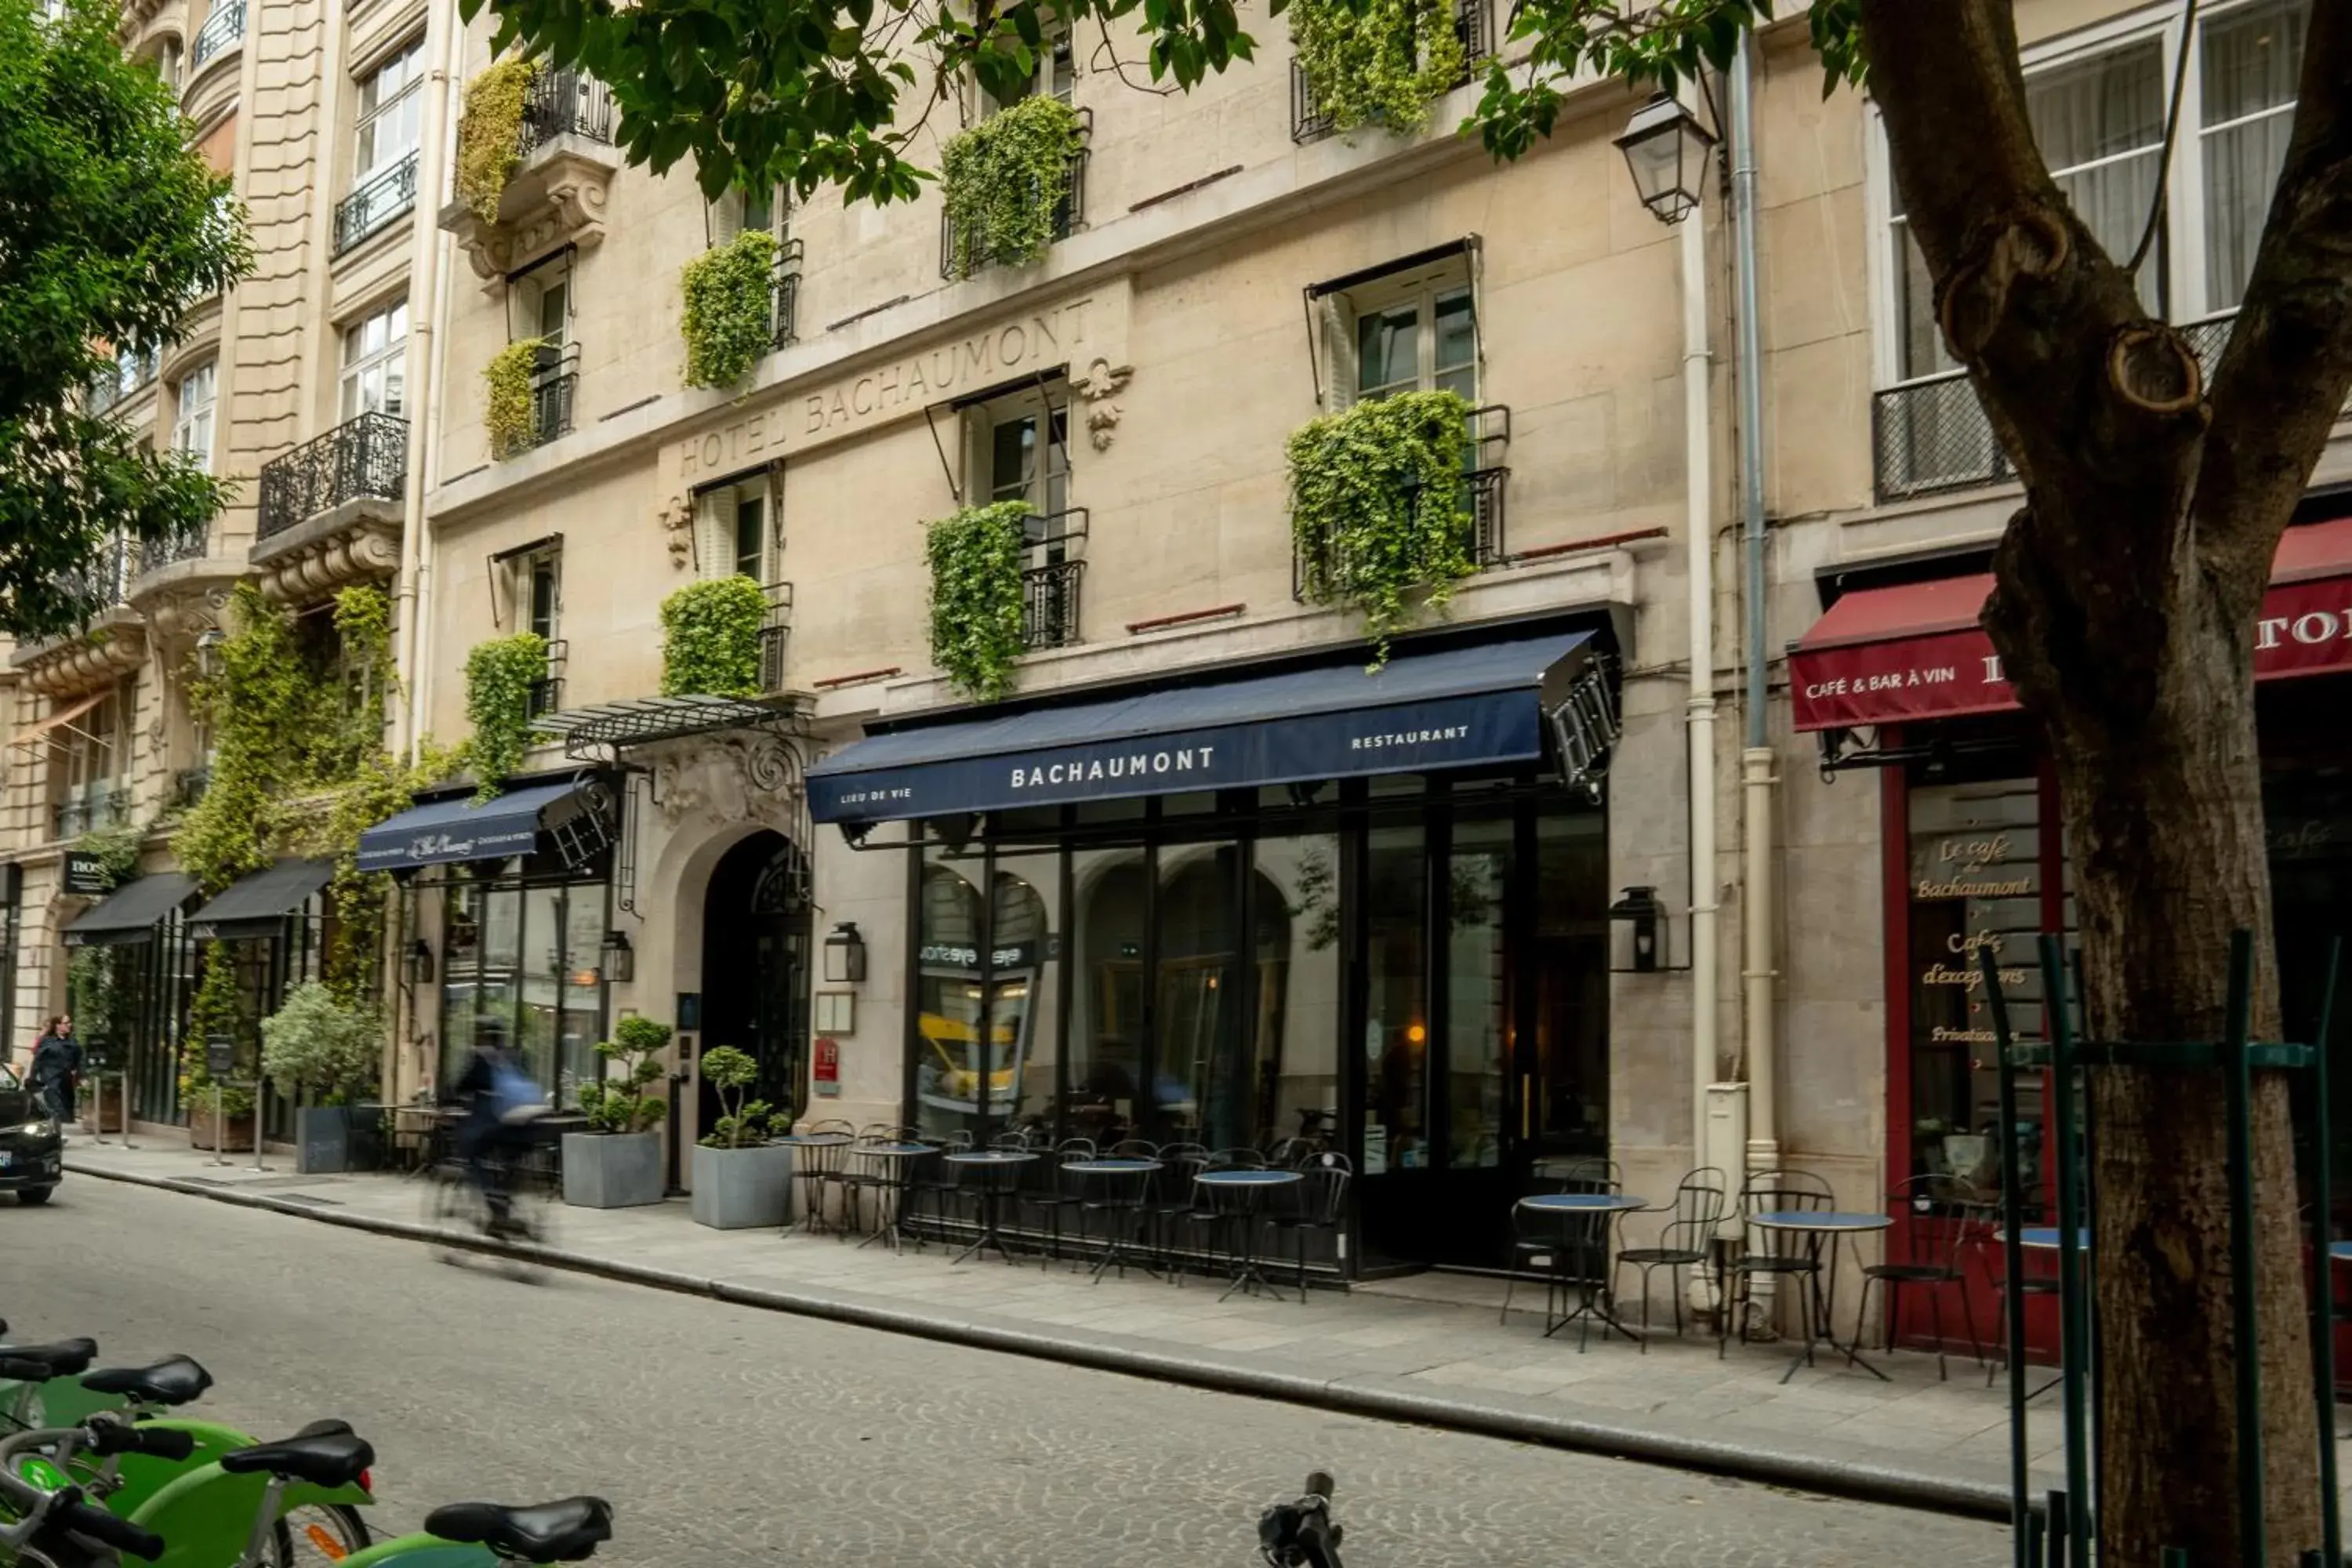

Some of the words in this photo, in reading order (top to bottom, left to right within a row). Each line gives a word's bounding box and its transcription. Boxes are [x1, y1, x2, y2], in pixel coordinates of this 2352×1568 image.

[680, 411, 786, 477] HOTEL
[805, 299, 1093, 434] BACHAUMONT
[1806, 677, 1846, 699] CAFÉ
[1853, 678, 1864, 693] &
[1869, 673, 1901, 691] BAR
[1907, 670, 1919, 687] À
[1923, 667, 1955, 684] VIN
[1352, 725, 1468, 750] RESTAURANT
[1011, 747, 1214, 788] BACHAUMONT
[871, 790, 886, 800] DE
[891, 788, 913, 799] VIE
[1940, 840, 1963, 862] Le
[1918, 876, 2031, 897] Bachaumont
